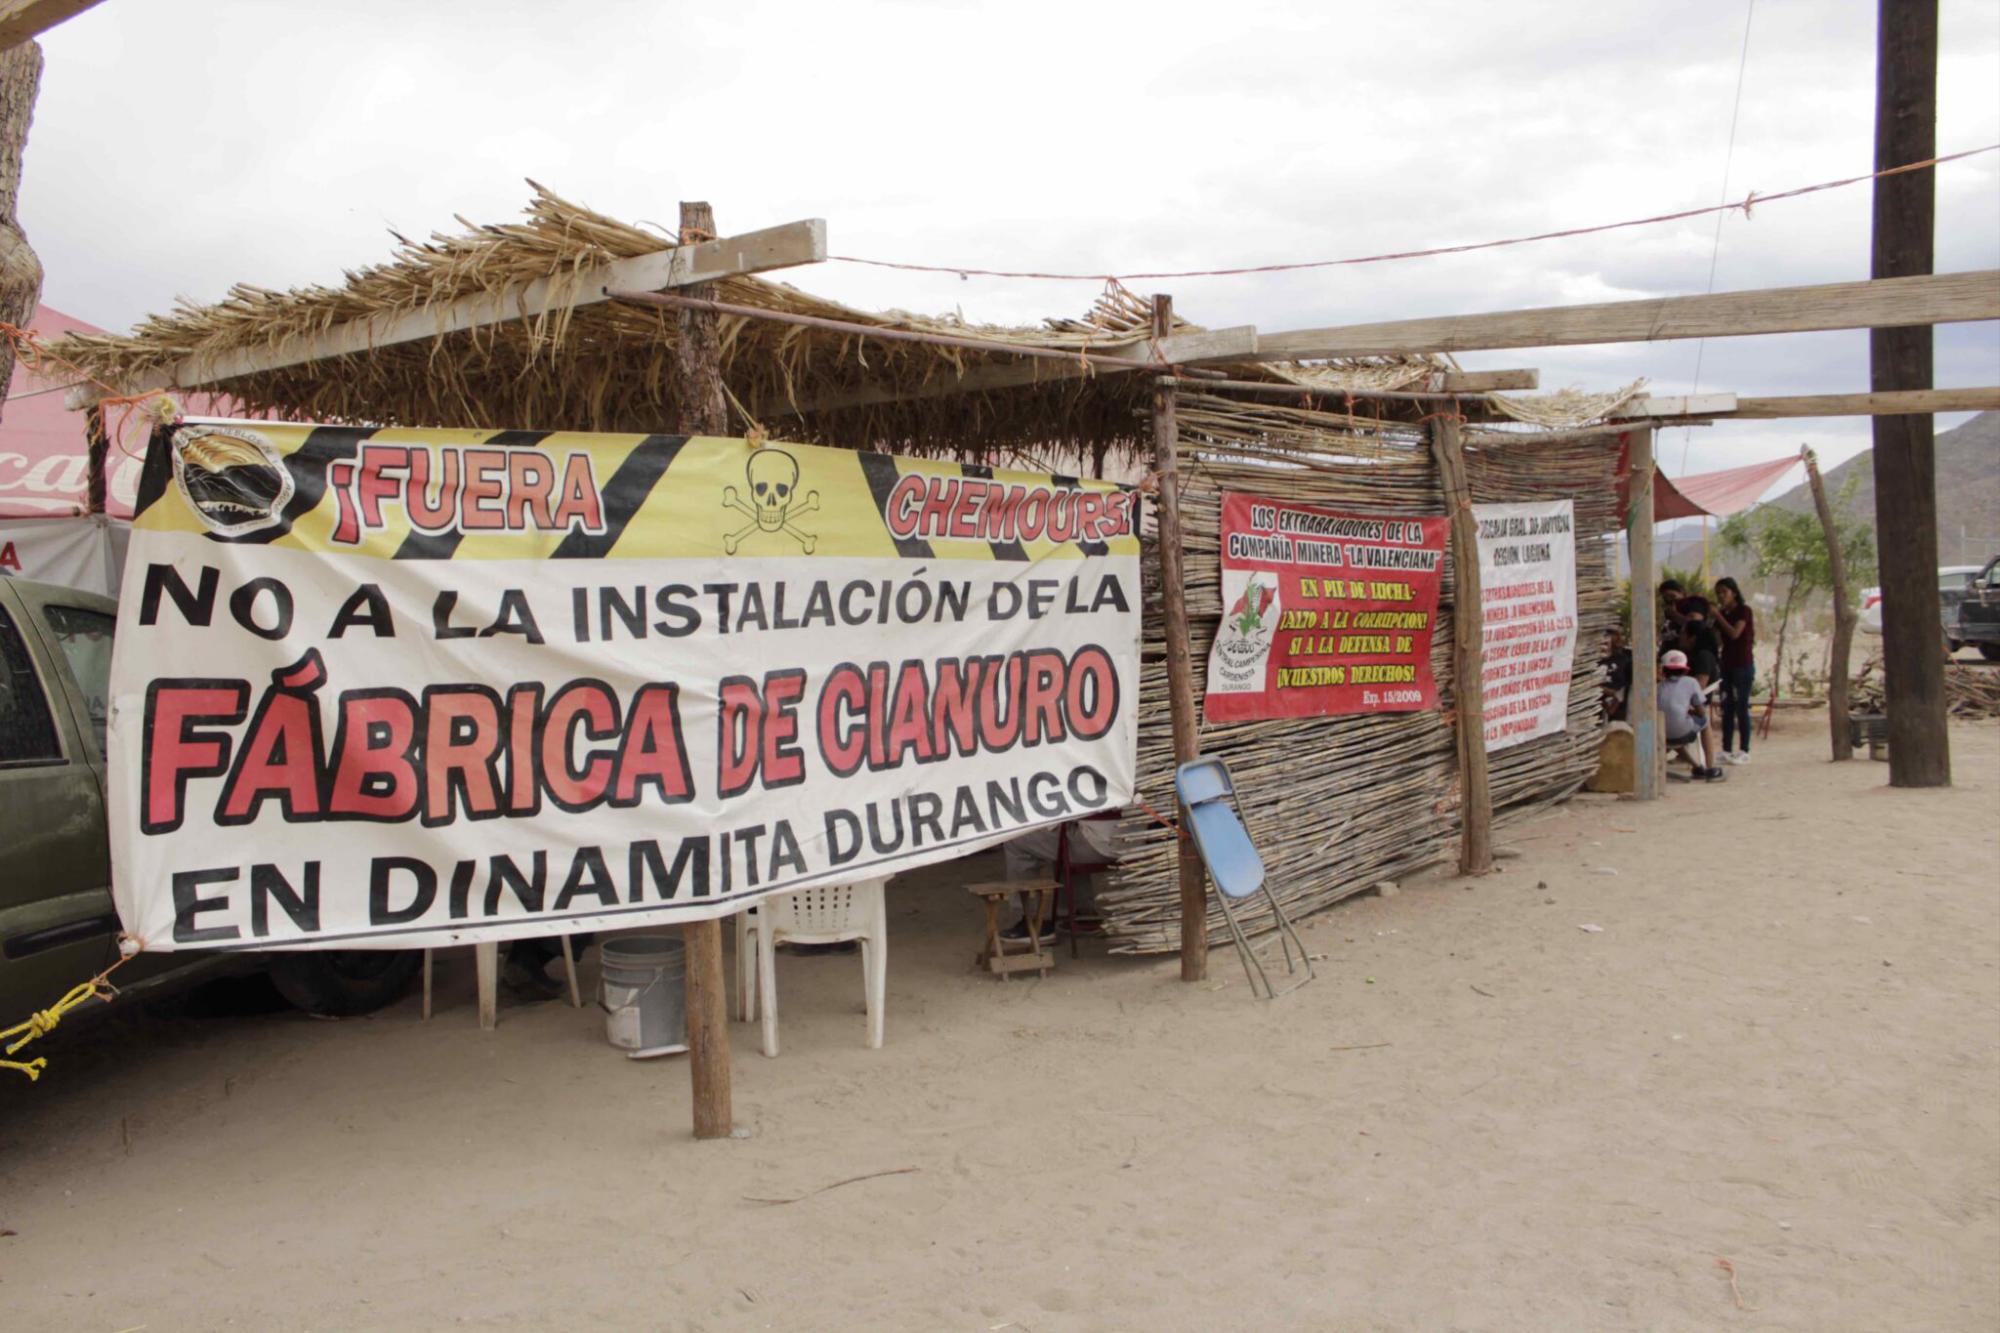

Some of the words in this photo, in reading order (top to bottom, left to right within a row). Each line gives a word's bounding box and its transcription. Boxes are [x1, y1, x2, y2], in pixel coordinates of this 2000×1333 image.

[331, 445, 603, 545] ¡FUERA
[889, 475, 1137, 543] CHEMOURS!
[1252, 506, 1274, 530] LOS
[1387, 521, 1403, 542] DE
[1407, 522, 1423, 543] LA
[1297, 540, 1342, 565] MINERA
[139, 563, 293, 641] NO
[327, 583, 396, 639] A
[433, 588, 544, 644] LA
[572, 567, 969, 643] INSTALACIÓN
[988, 579, 1059, 621] DE
[1064, 573, 1130, 614] LA
[1301, 578, 1318, 598] EN
[1324, 579, 1346, 599] PIE
[1350, 580, 1367, 600] DE
[1304, 638, 1314, 655] A
[1318, 637, 1334, 655] LA
[1339, 635, 1391, 655] DEFENSA
[1396, 635, 1413, 654] DE
[1319, 612, 1331, 630] A
[1332, 612, 1348, 630] LA
[140, 647, 695, 836] FÁBRICA
[717, 667, 806, 800] DE
[816, 643, 1120, 779] CIANURO
[172, 860, 321, 943] EN
[369, 819, 808, 927] DINAMITA
[823, 765, 1109, 867] DURANGO
